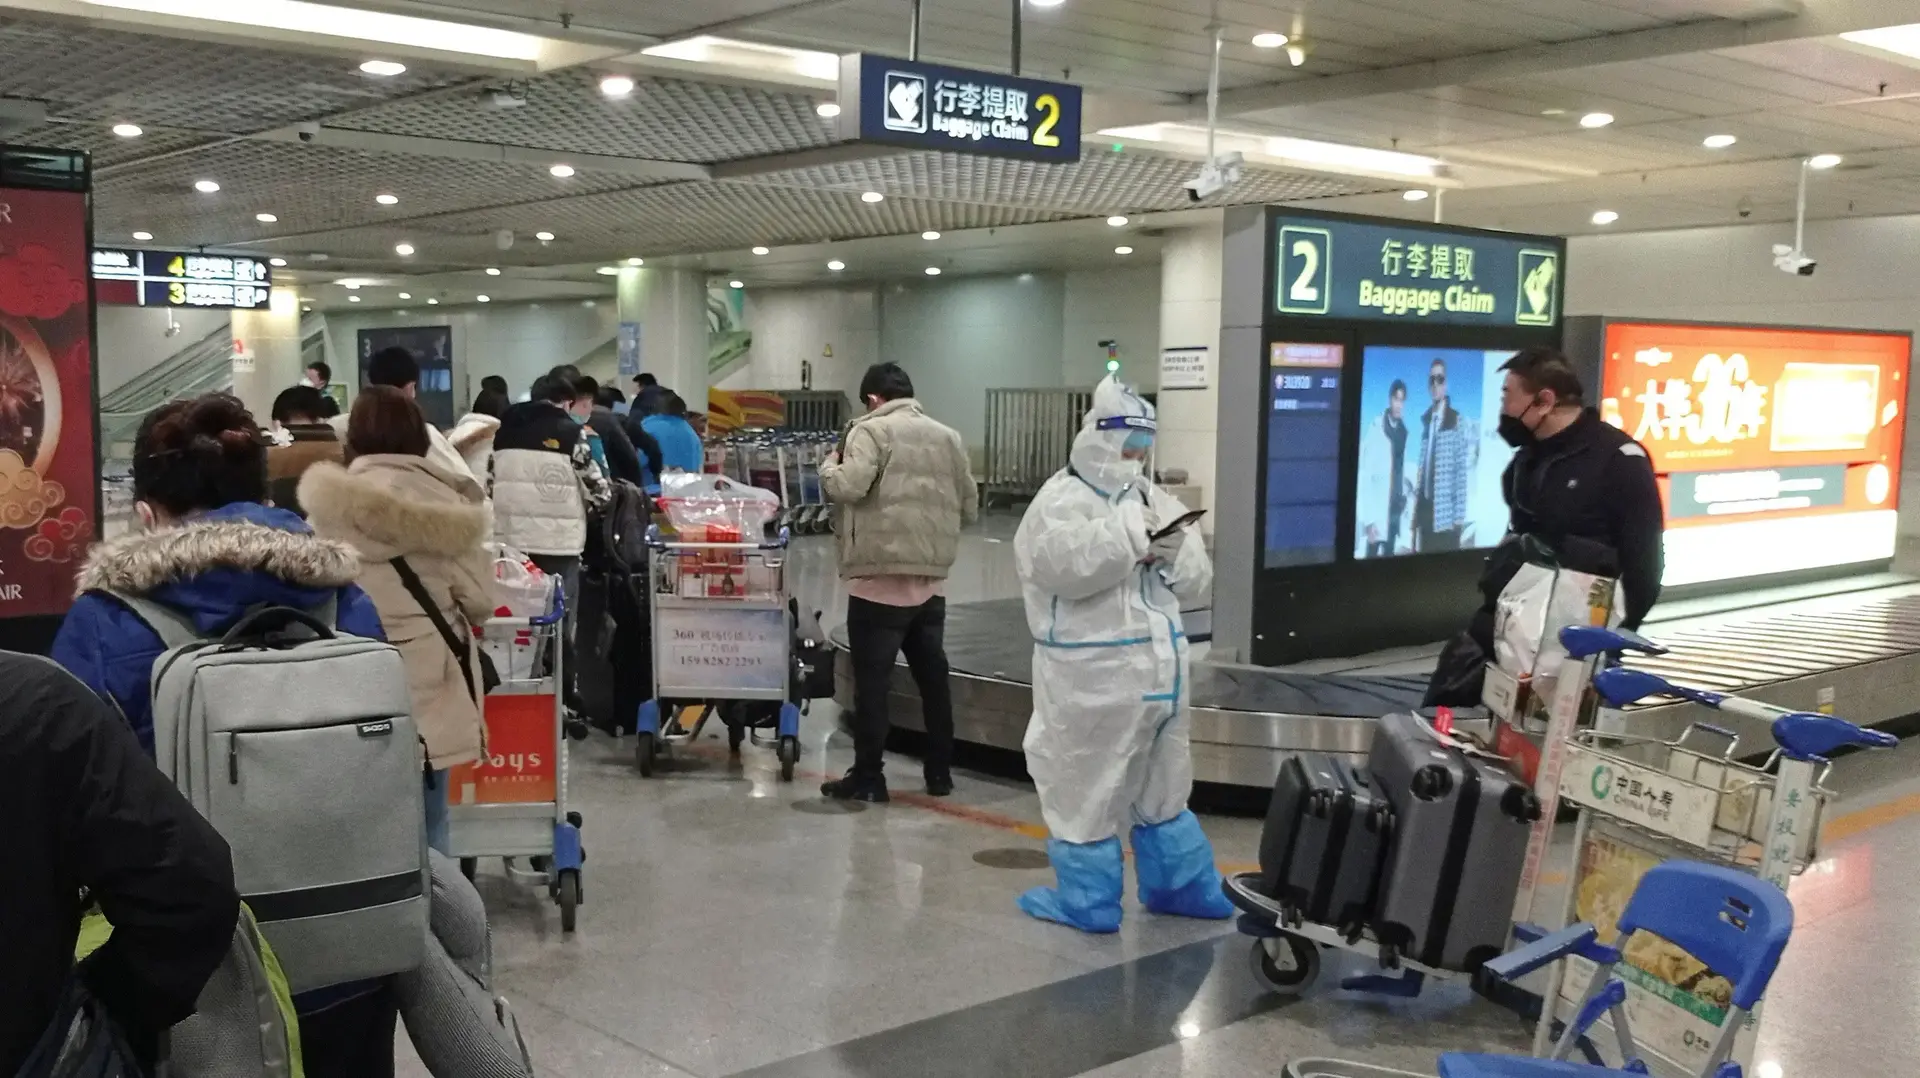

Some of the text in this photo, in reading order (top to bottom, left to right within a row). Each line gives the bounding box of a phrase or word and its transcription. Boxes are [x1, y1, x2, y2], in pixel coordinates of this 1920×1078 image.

[933, 79, 1029, 122] 行李提取
[932, 113, 1029, 141] Baggage Claim
[1032, 93, 1060, 147] 2
[168, 255, 185, 277] 4
[1290, 239, 1318, 301] 2
[1380, 238, 1475, 281] 行李提取
[168, 282, 185, 305] 3
[1359, 279, 1496, 317] Baggage Claim
[1616, 774, 1674, 808] 中国人寿
